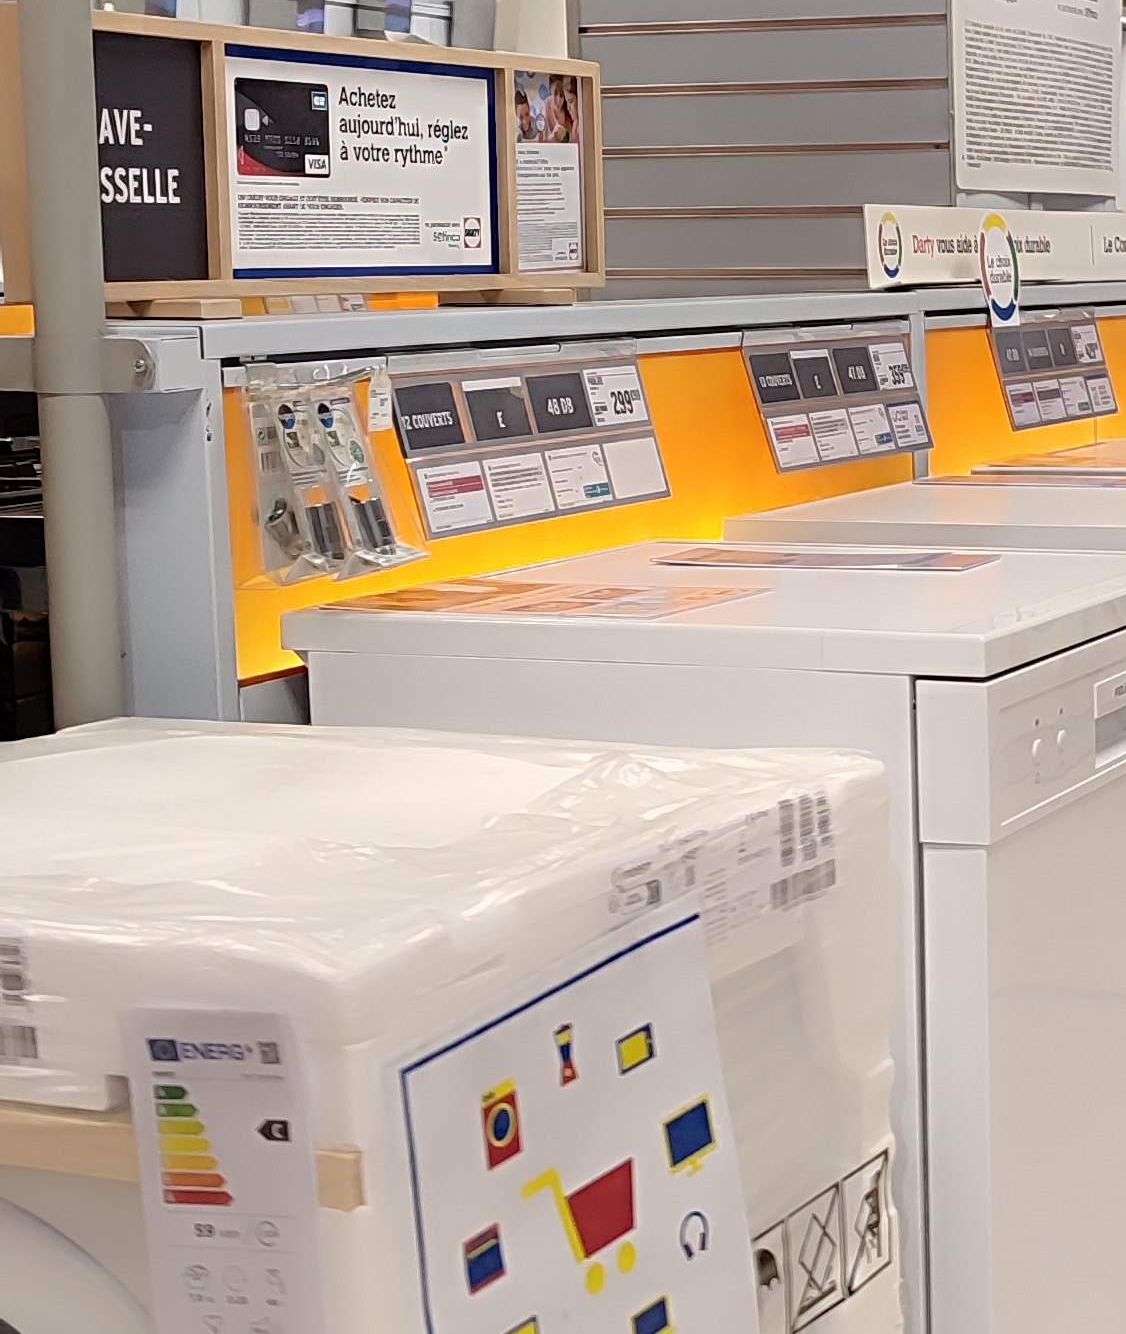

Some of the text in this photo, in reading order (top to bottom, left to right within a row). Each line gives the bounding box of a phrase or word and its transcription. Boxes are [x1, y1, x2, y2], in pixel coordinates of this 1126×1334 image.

[338, 86, 396, 108] Achetez
[99, 108, 152, 145] AVE-
[339, 114, 424, 140] aujourd'hui,
[428, 119, 468, 143] réglez
[340, 140, 348, 161] à
[353, 143, 390, 163] votre
[307, 158, 327, 169] VISA
[101, 167, 180, 203] SSELLE
[912, 235, 934, 257] Darty
[936, 238, 955, 253] vous
[956, 235, 972, 253] aide
[973, 235, 978, 253] à
[1103, 236, 1112, 253] Le
[988, 253, 1011, 268] Le choix
[547, 396, 575, 415] 48 DB
[412, 411, 453, 429] COUVERTS
